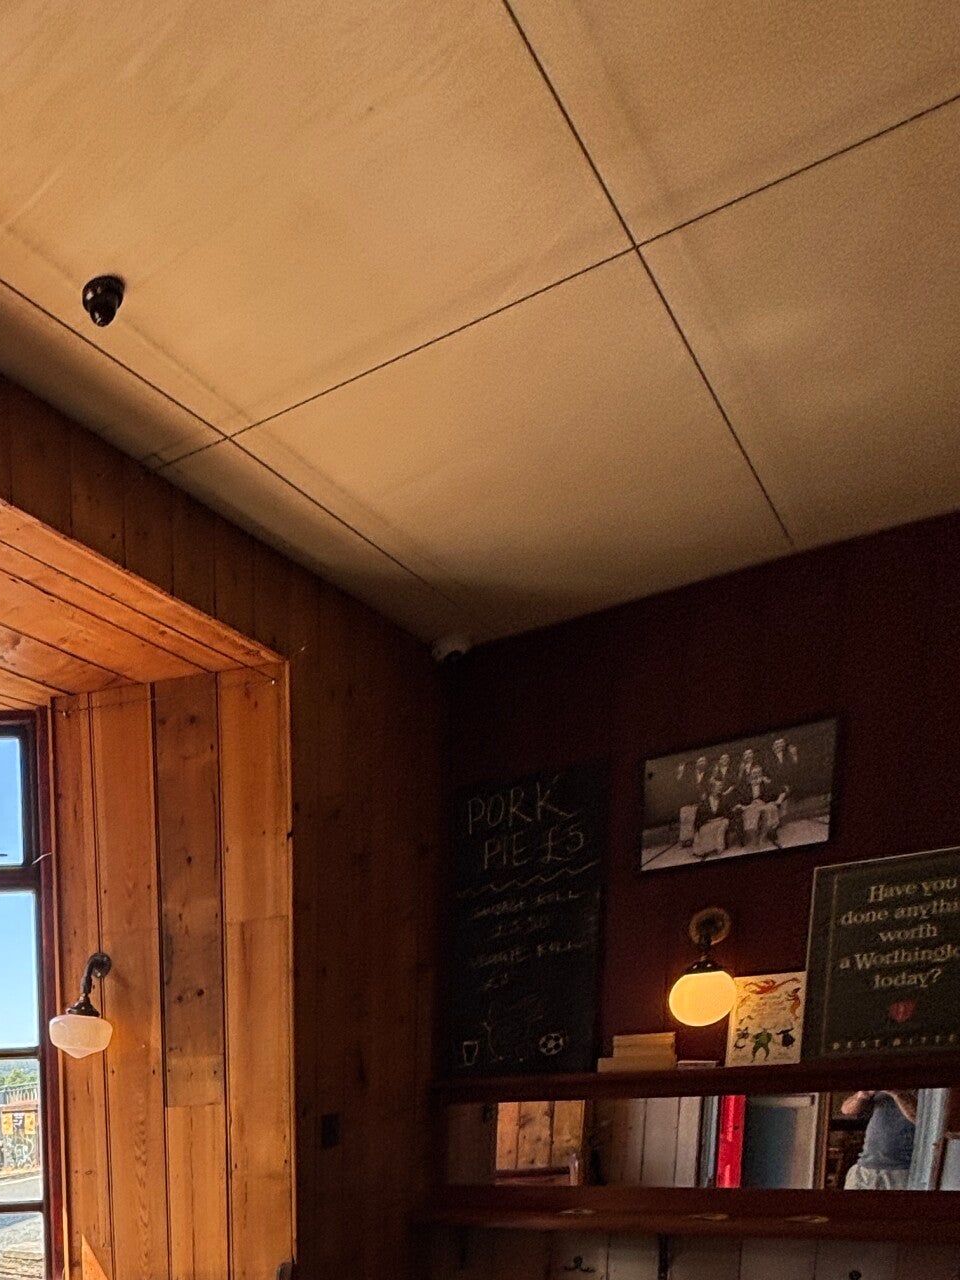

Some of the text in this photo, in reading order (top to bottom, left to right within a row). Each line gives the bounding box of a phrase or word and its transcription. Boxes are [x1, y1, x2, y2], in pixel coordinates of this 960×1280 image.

[467, 774, 579, 835] PORK
[483, 821, 586, 870] PIE £5
[867, 877, 959, 902] Have you
[839, 908, 890, 926] done
[878, 923, 939, 943] worth
[838, 956, 851, 970] a
[872, 968, 943, 989] today?
